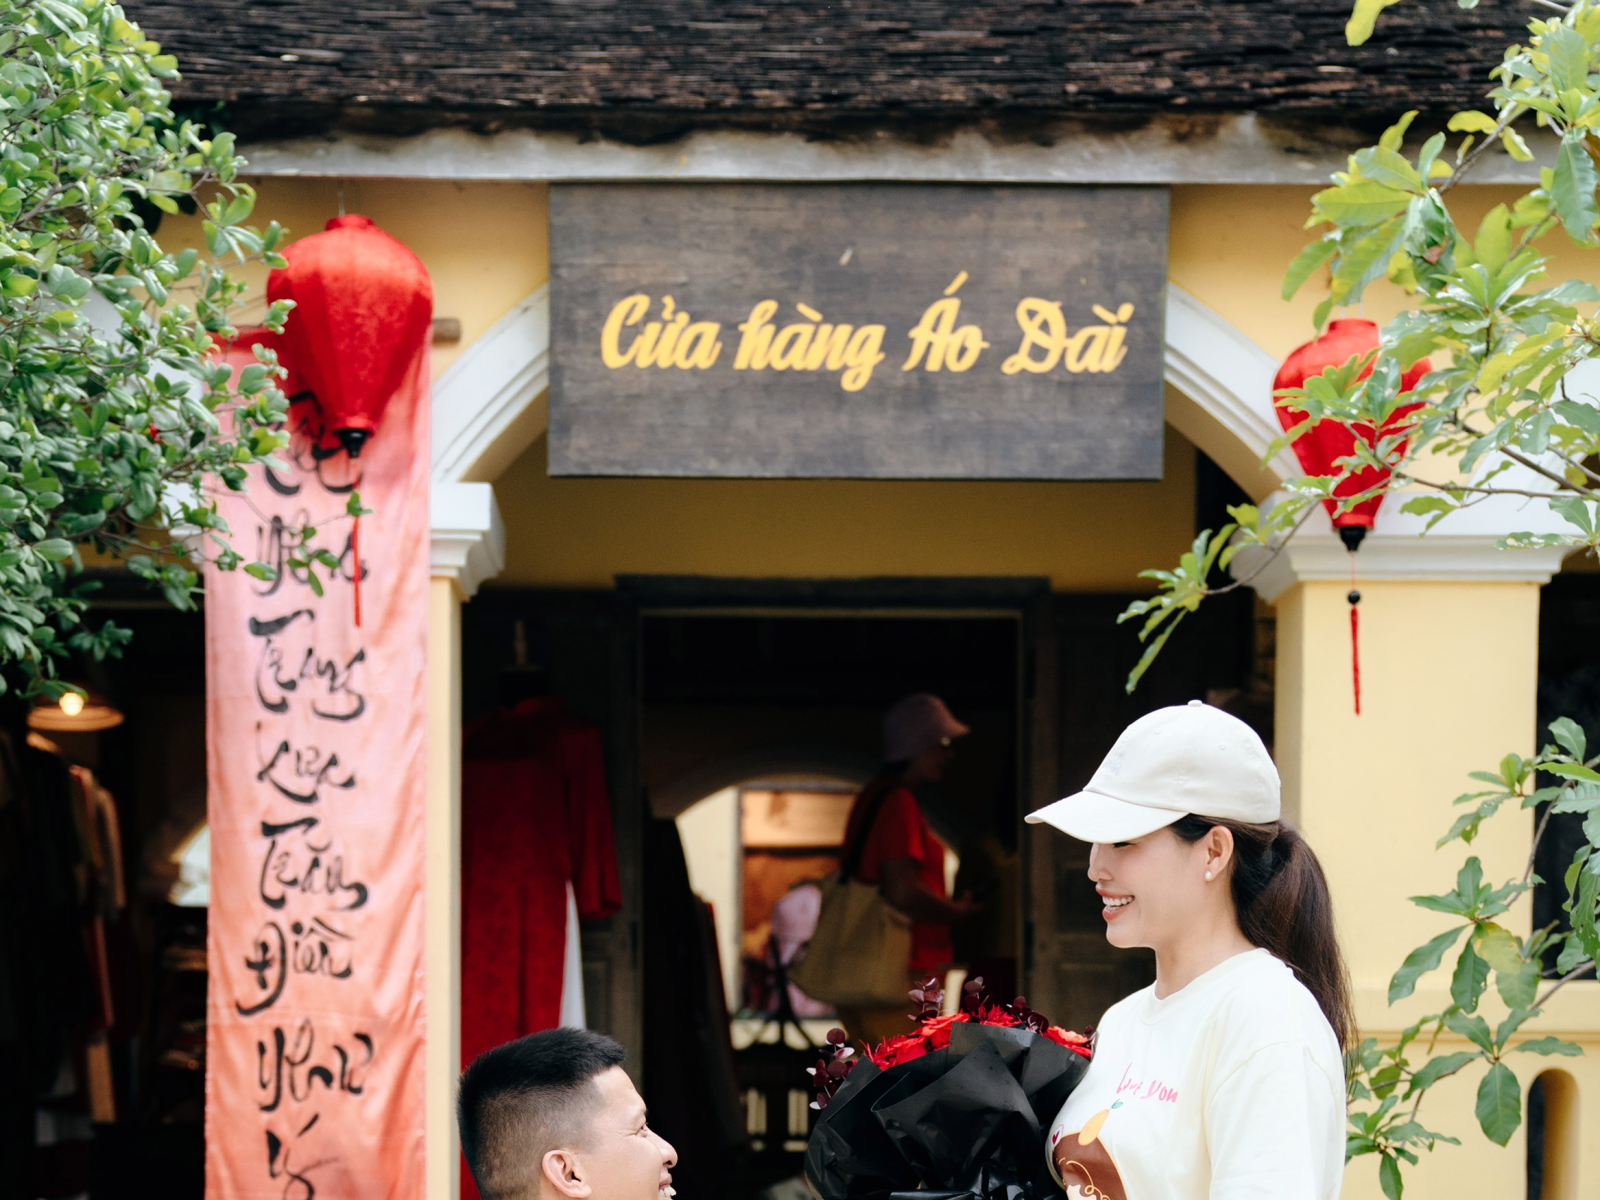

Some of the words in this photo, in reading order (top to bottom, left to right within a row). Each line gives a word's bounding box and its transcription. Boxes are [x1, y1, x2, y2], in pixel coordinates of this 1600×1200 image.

[600, 293, 722, 369] Cửa
[733, 300, 887, 392] hàng
[902, 270, 991, 373] Áo
